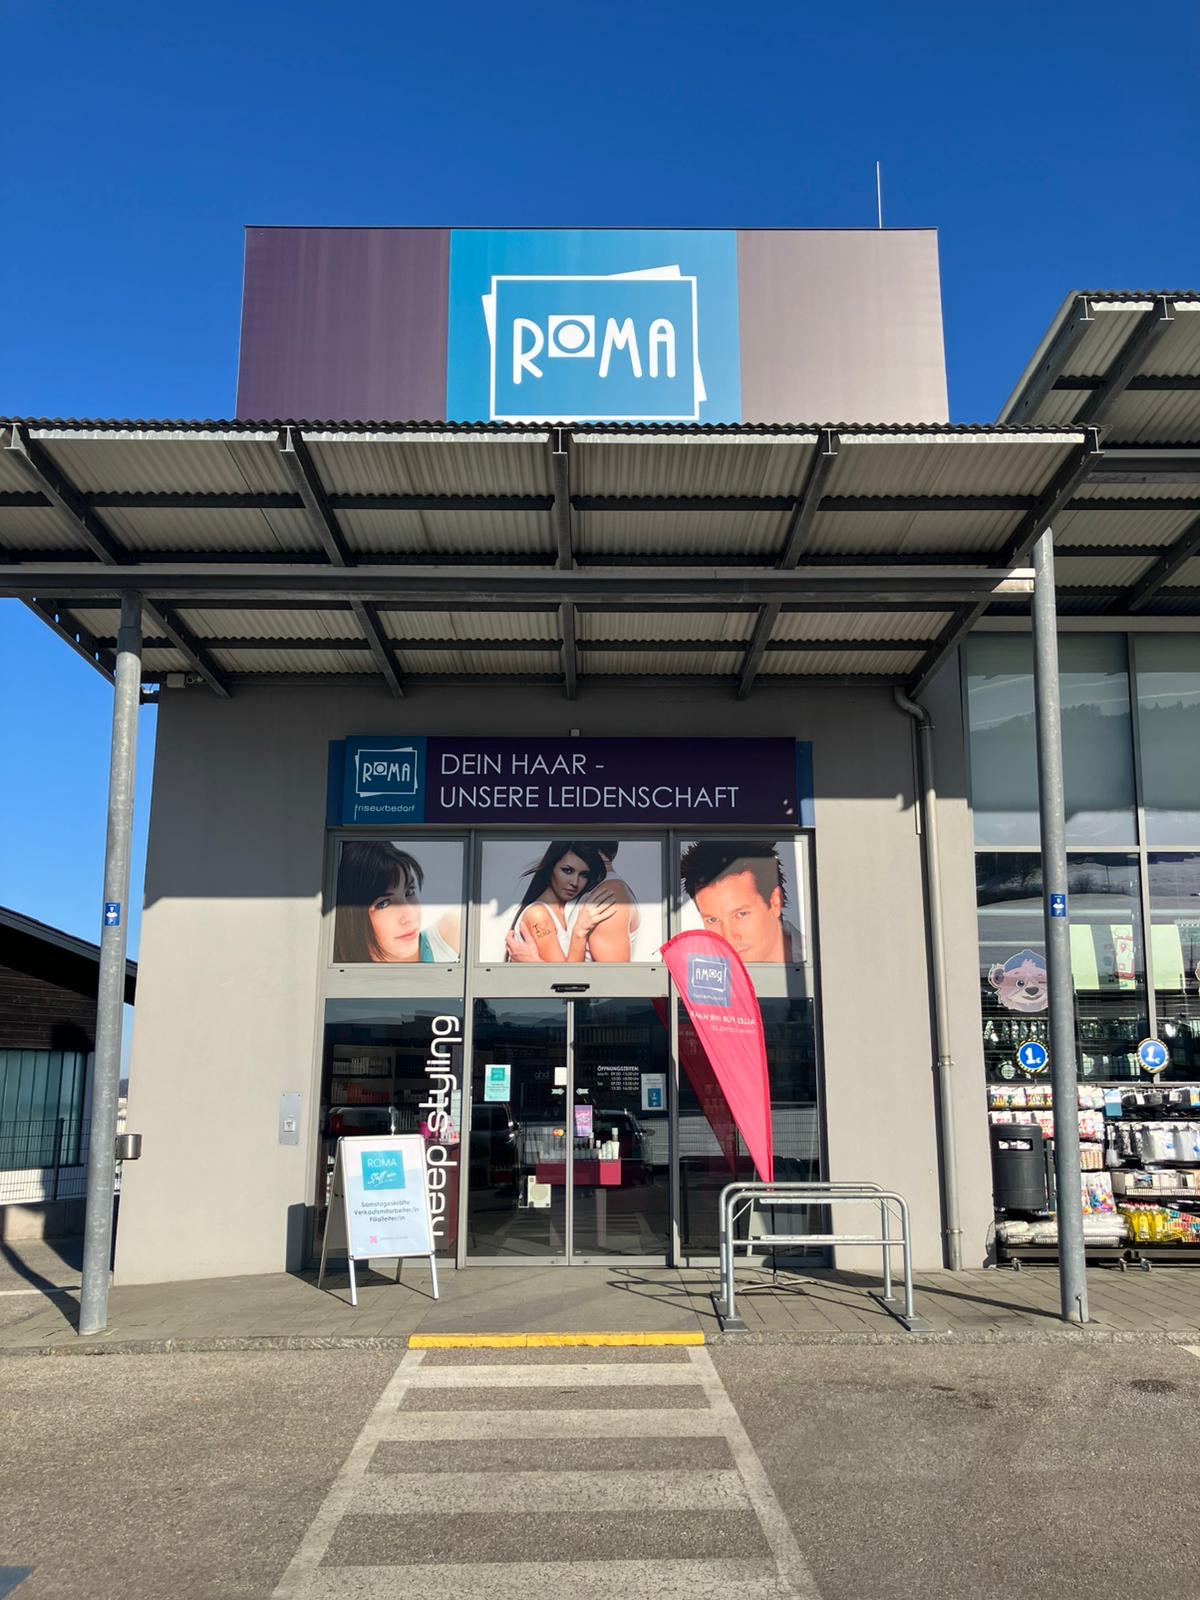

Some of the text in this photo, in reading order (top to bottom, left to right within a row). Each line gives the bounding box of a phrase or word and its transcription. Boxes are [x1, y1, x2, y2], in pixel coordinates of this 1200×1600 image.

[512, 314, 676, 385] ROMA
[362, 761, 411, 784] ROMA
[441, 753, 502, 775] DEIN
[511, 753, 587, 775] HAAR
[439, 786, 740, 808] UNSERE LEIDENSCHAFT
[418, 1014, 463, 1134] styling
[367, 1158, 398, 1168] ROMA
